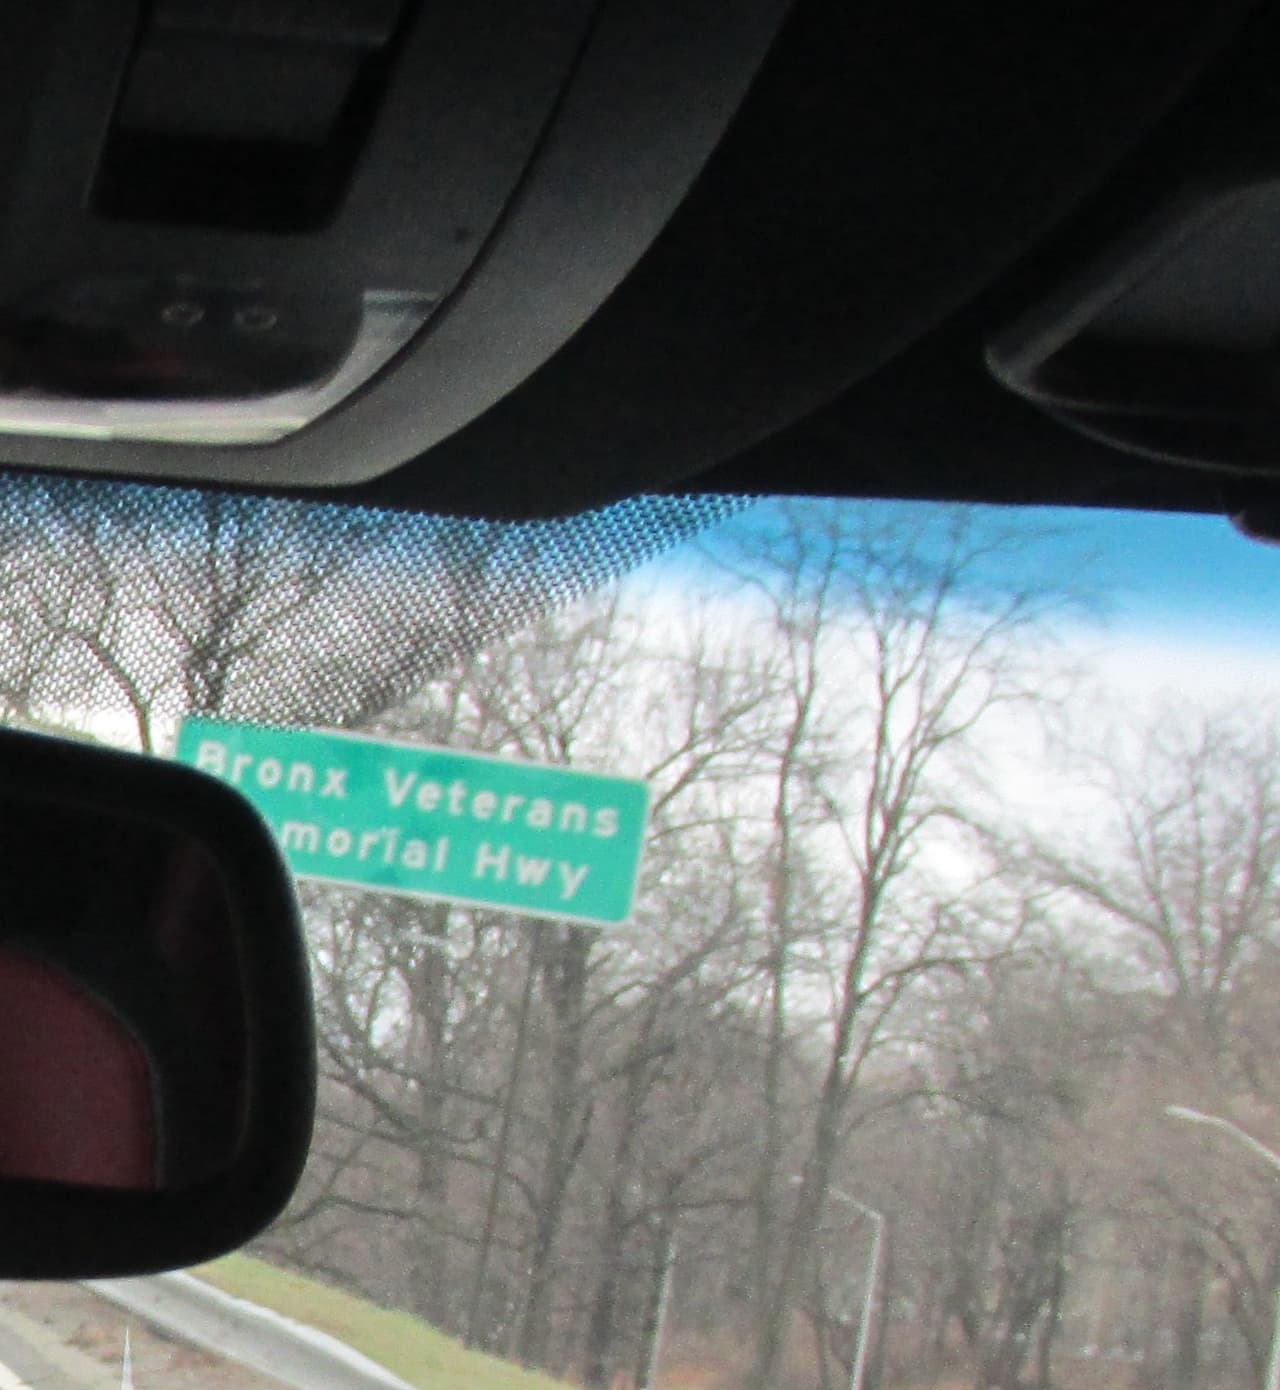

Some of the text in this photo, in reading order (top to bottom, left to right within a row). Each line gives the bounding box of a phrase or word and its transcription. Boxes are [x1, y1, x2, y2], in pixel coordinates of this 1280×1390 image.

[196, 740, 621, 838] Bronx Veterans
[281, 820, 590, 900] morial Hwy
